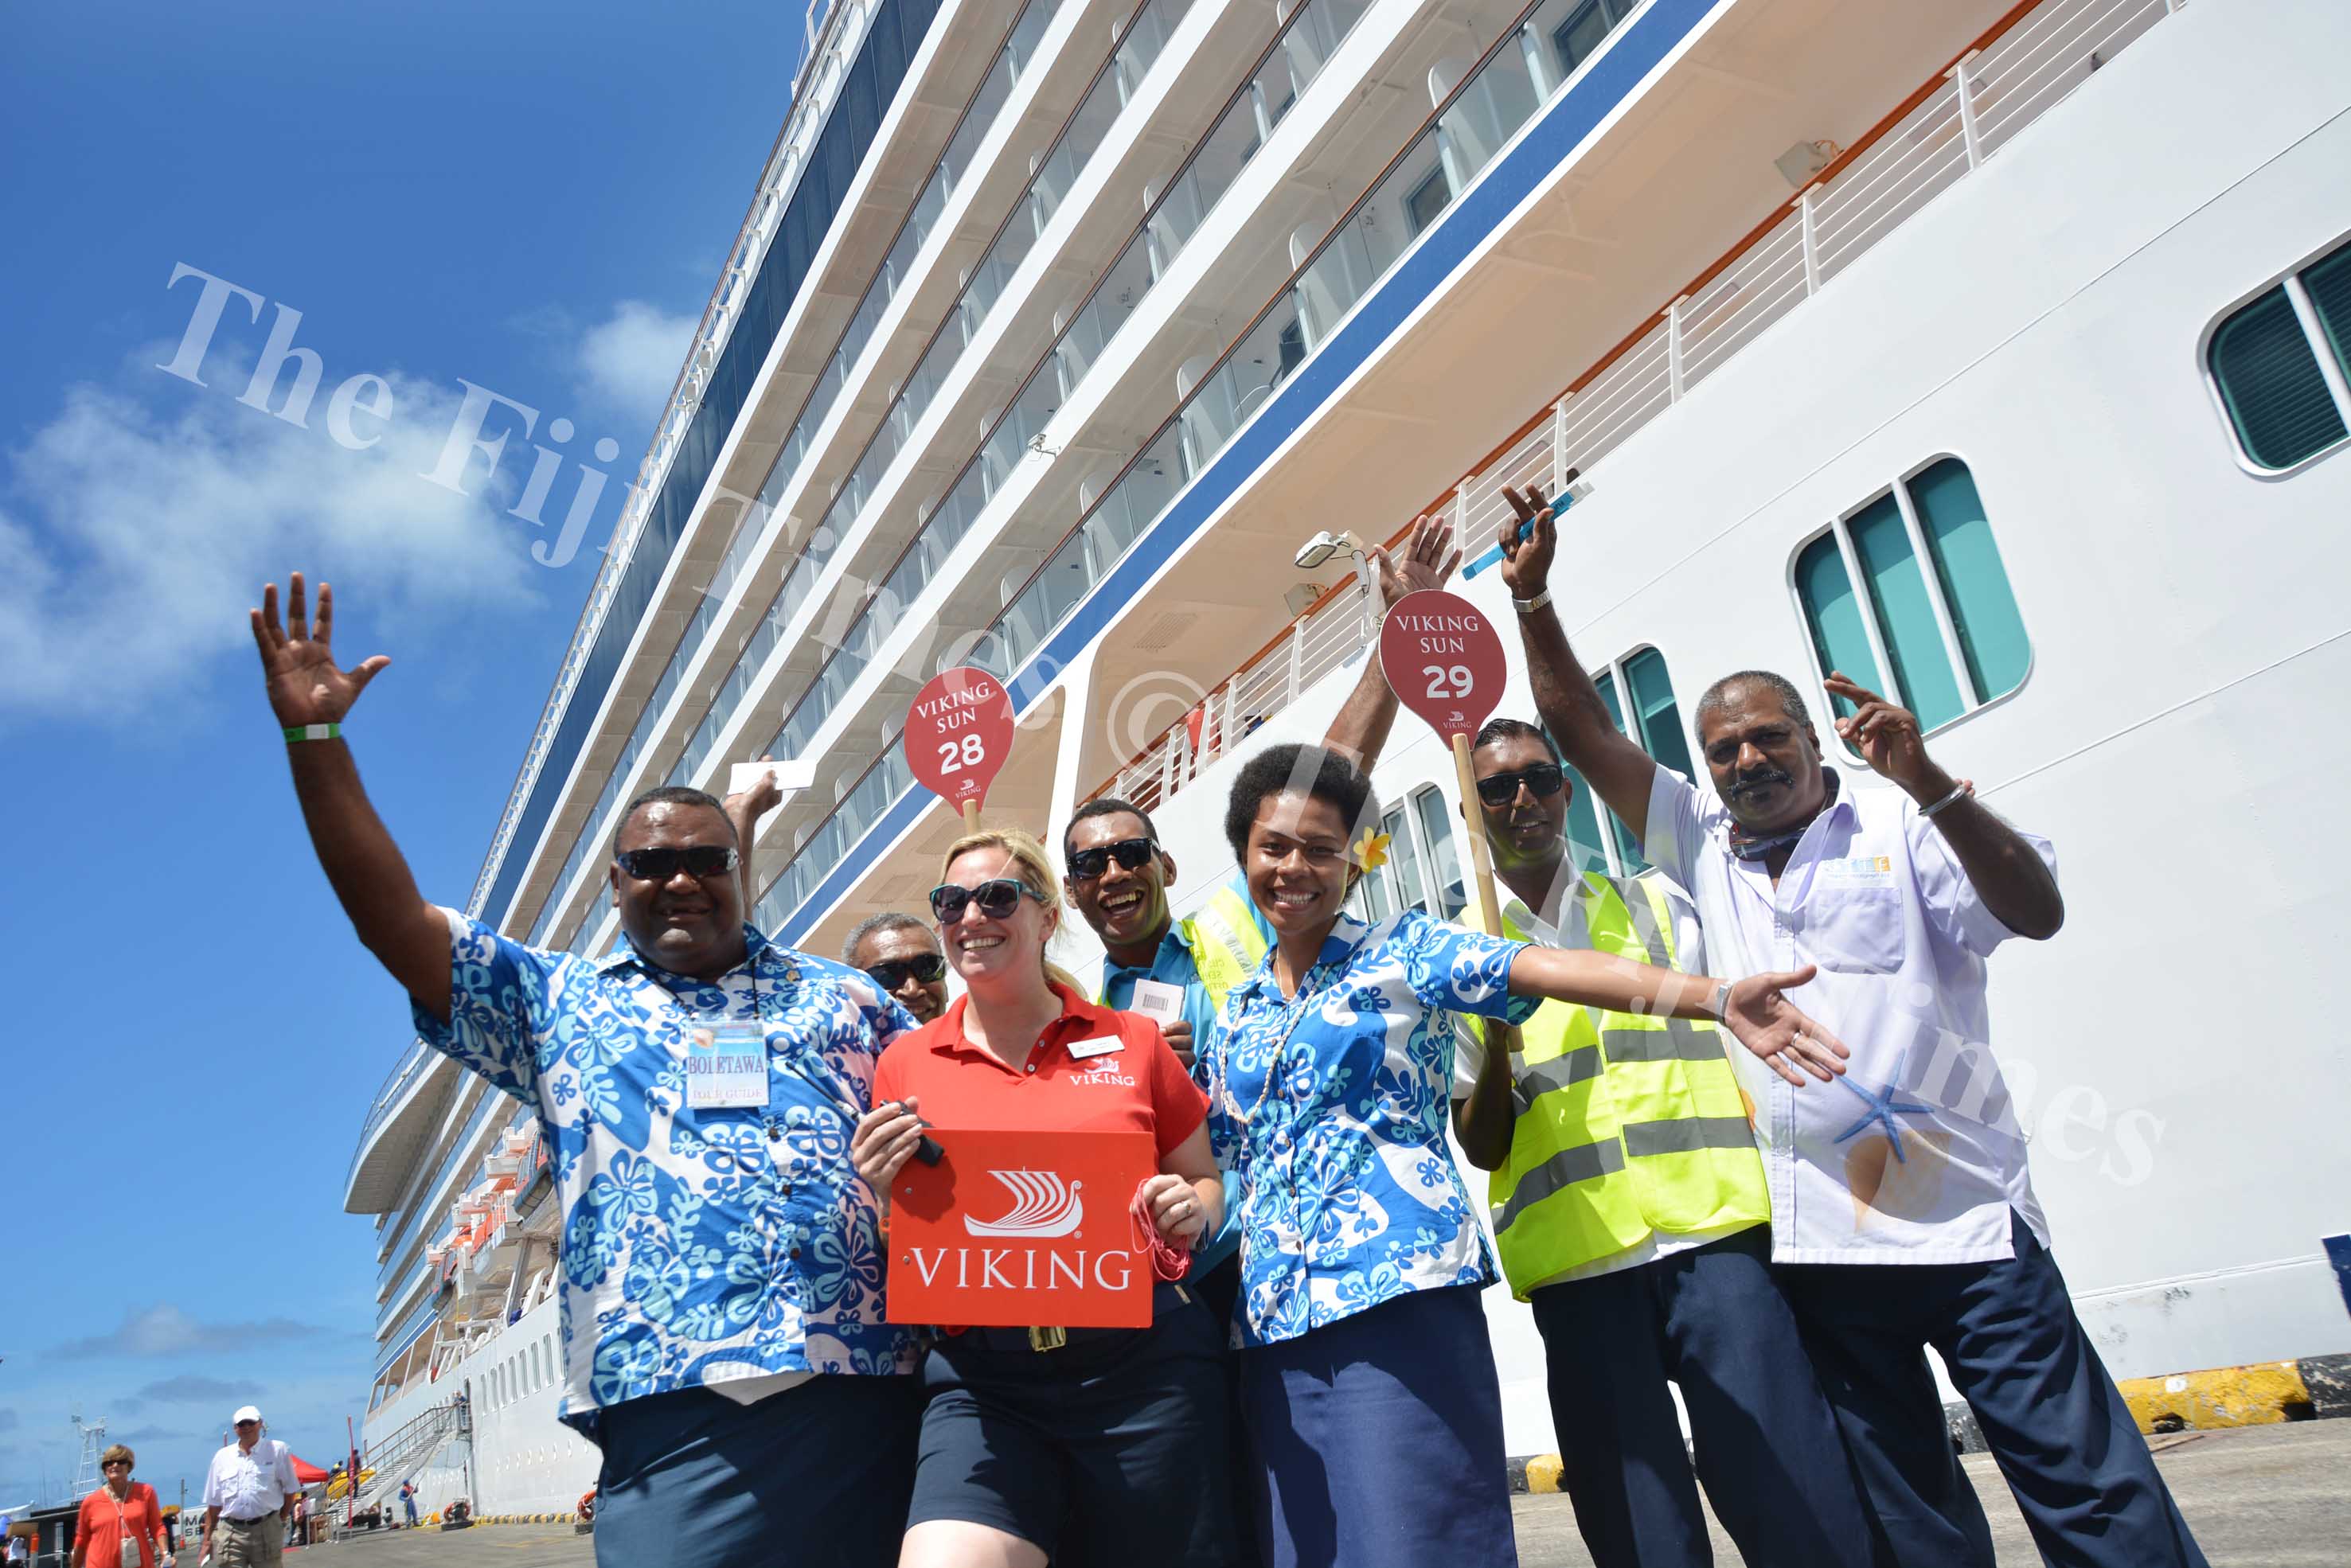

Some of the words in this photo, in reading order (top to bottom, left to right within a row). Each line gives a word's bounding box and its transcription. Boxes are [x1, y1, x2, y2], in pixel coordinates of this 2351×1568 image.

[1395, 615, 1478, 632] VIKING
[1420, 638, 1465, 653] SUN
[1422, 665, 1474, 699] 29
[916, 682, 990, 720] VIKING
[936, 707, 976, 734] SUN
[1443, 721, 1472, 730] VIKING
[938, 733, 985, 776] 28
[955, 785, 982, 799] VIKING
[688, 1055, 765, 1075] BOLETAWA
[1069, 1073, 1135, 1086] VIKING
[910, 1247, 1132, 1291] VIKING
